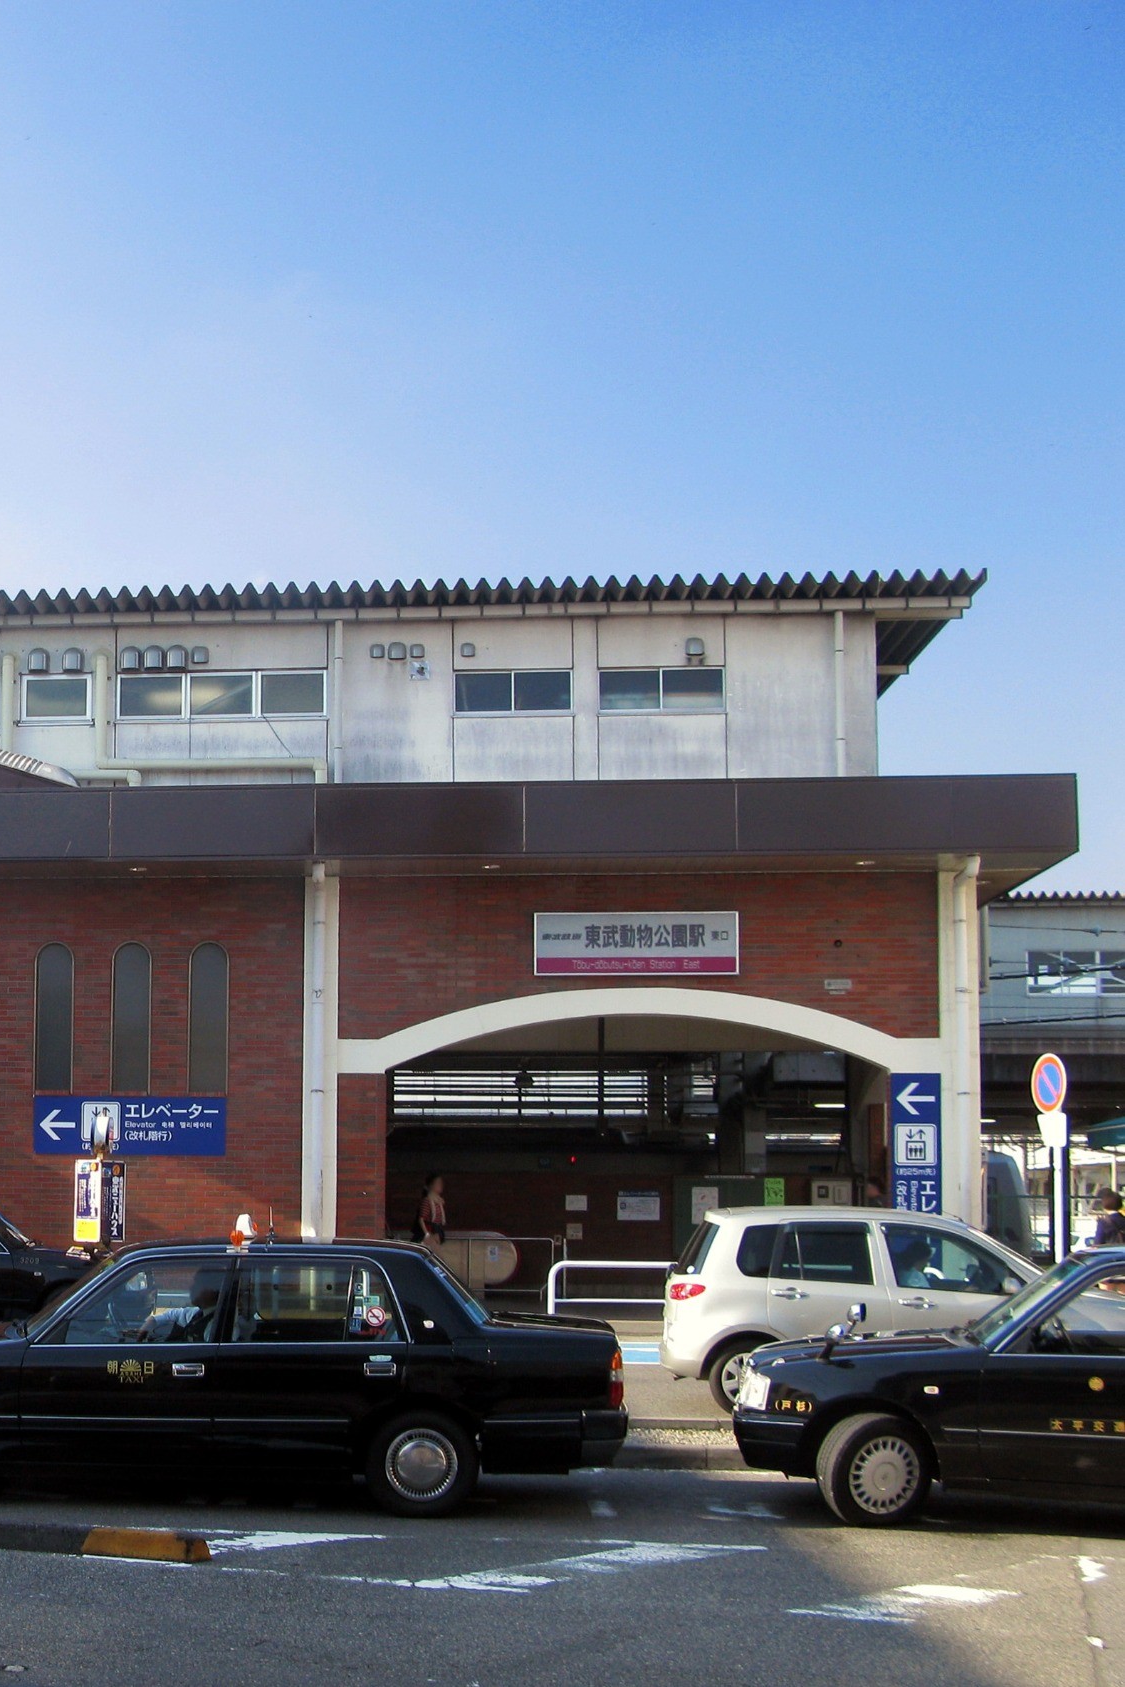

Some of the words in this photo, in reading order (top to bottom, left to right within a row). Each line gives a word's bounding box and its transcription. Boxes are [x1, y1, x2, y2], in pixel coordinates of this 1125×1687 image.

[584, 924, 706, 949] 東武動物公園駅
[711, 930, 729, 941] 東口
[649, 959, 676, 969] Station
[683, 959, 700, 969] East
[125, 1103, 219, 1119] エレベーター
[124, 1120, 156, 1128] Elevator
[124, 1130, 172, 1142] (改札階行)
[118, 1376, 144, 1384] TAXI
